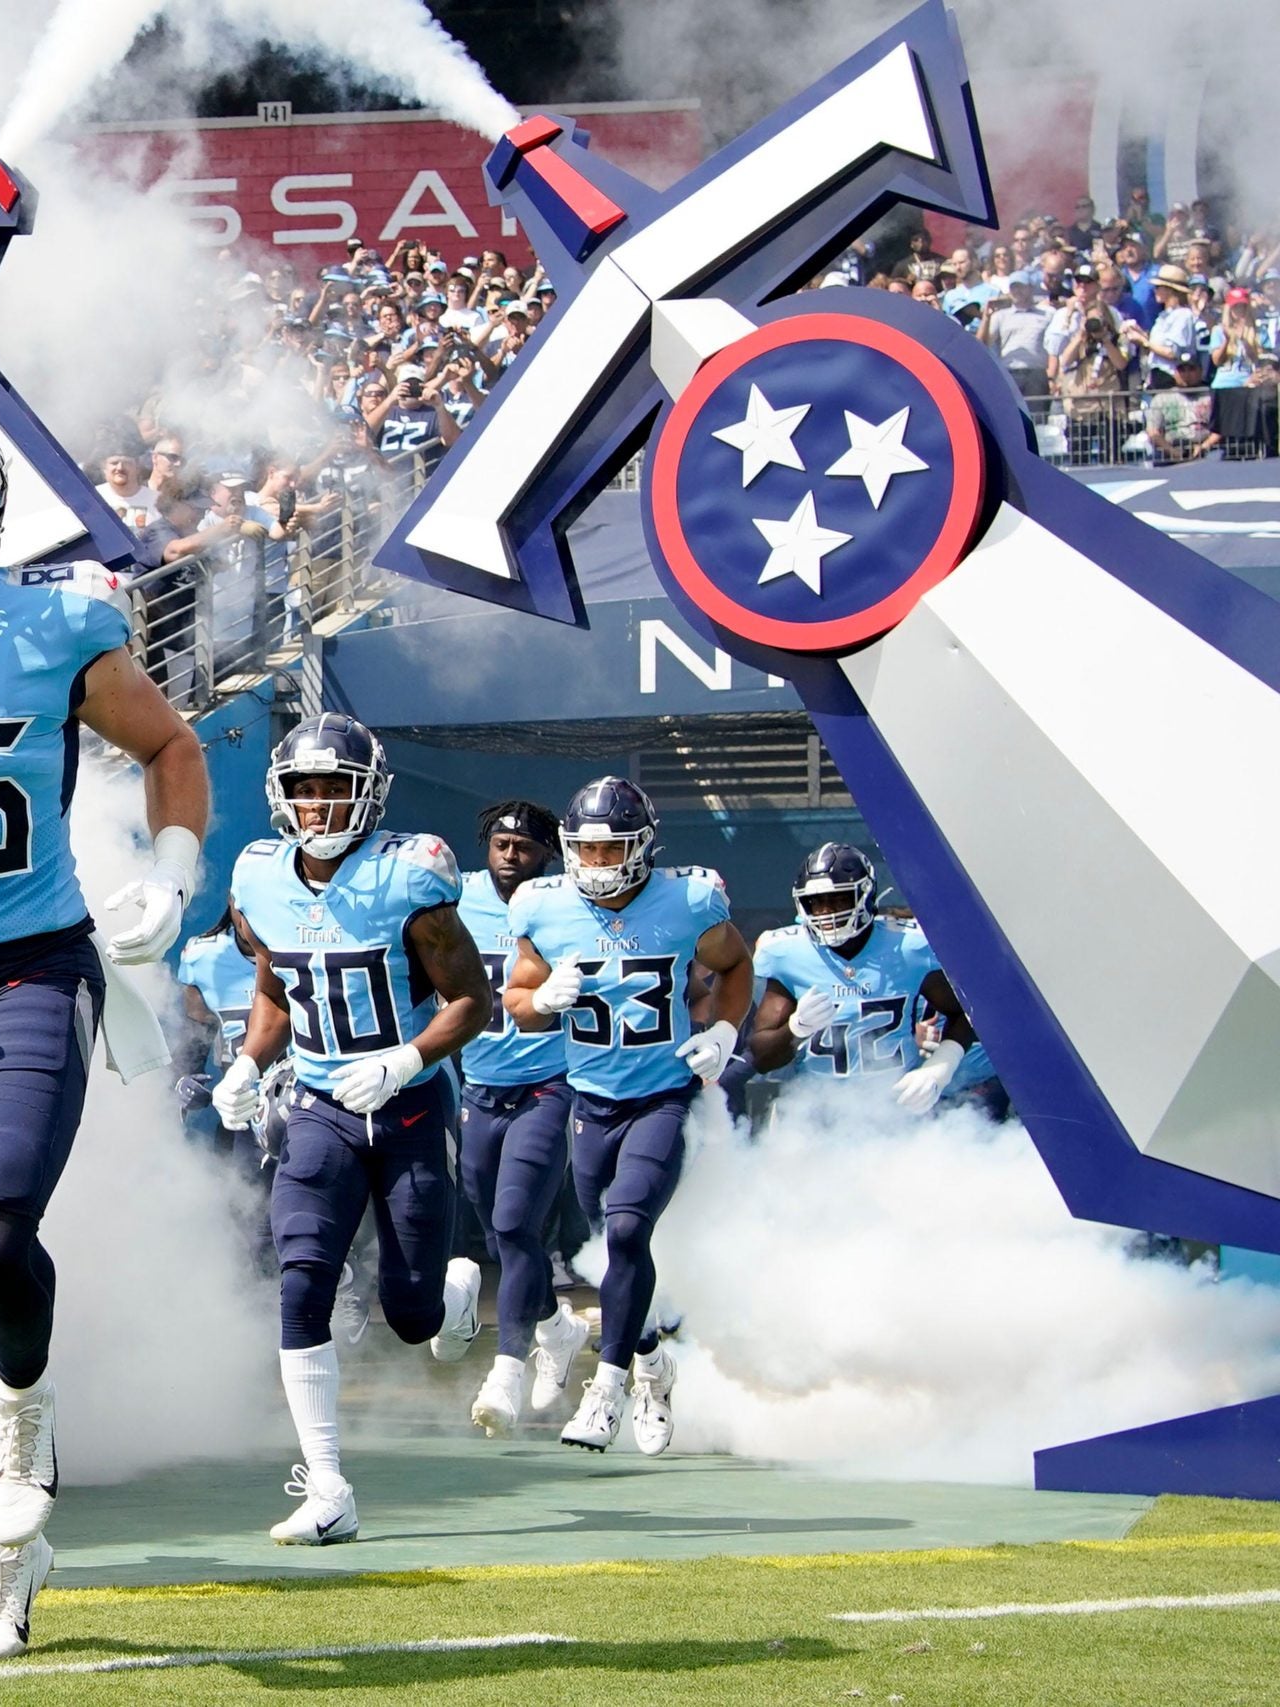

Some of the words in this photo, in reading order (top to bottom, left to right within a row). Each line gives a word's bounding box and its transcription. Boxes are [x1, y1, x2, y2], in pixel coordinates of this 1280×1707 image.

[263, 105, 287, 122] 141
[380, 419, 428, 451] 22
[595, 934, 640, 953] TITANS
[267, 944, 404, 1060] 30
[567, 954, 680, 1050] 53
[807, 995, 909, 1079] 42
